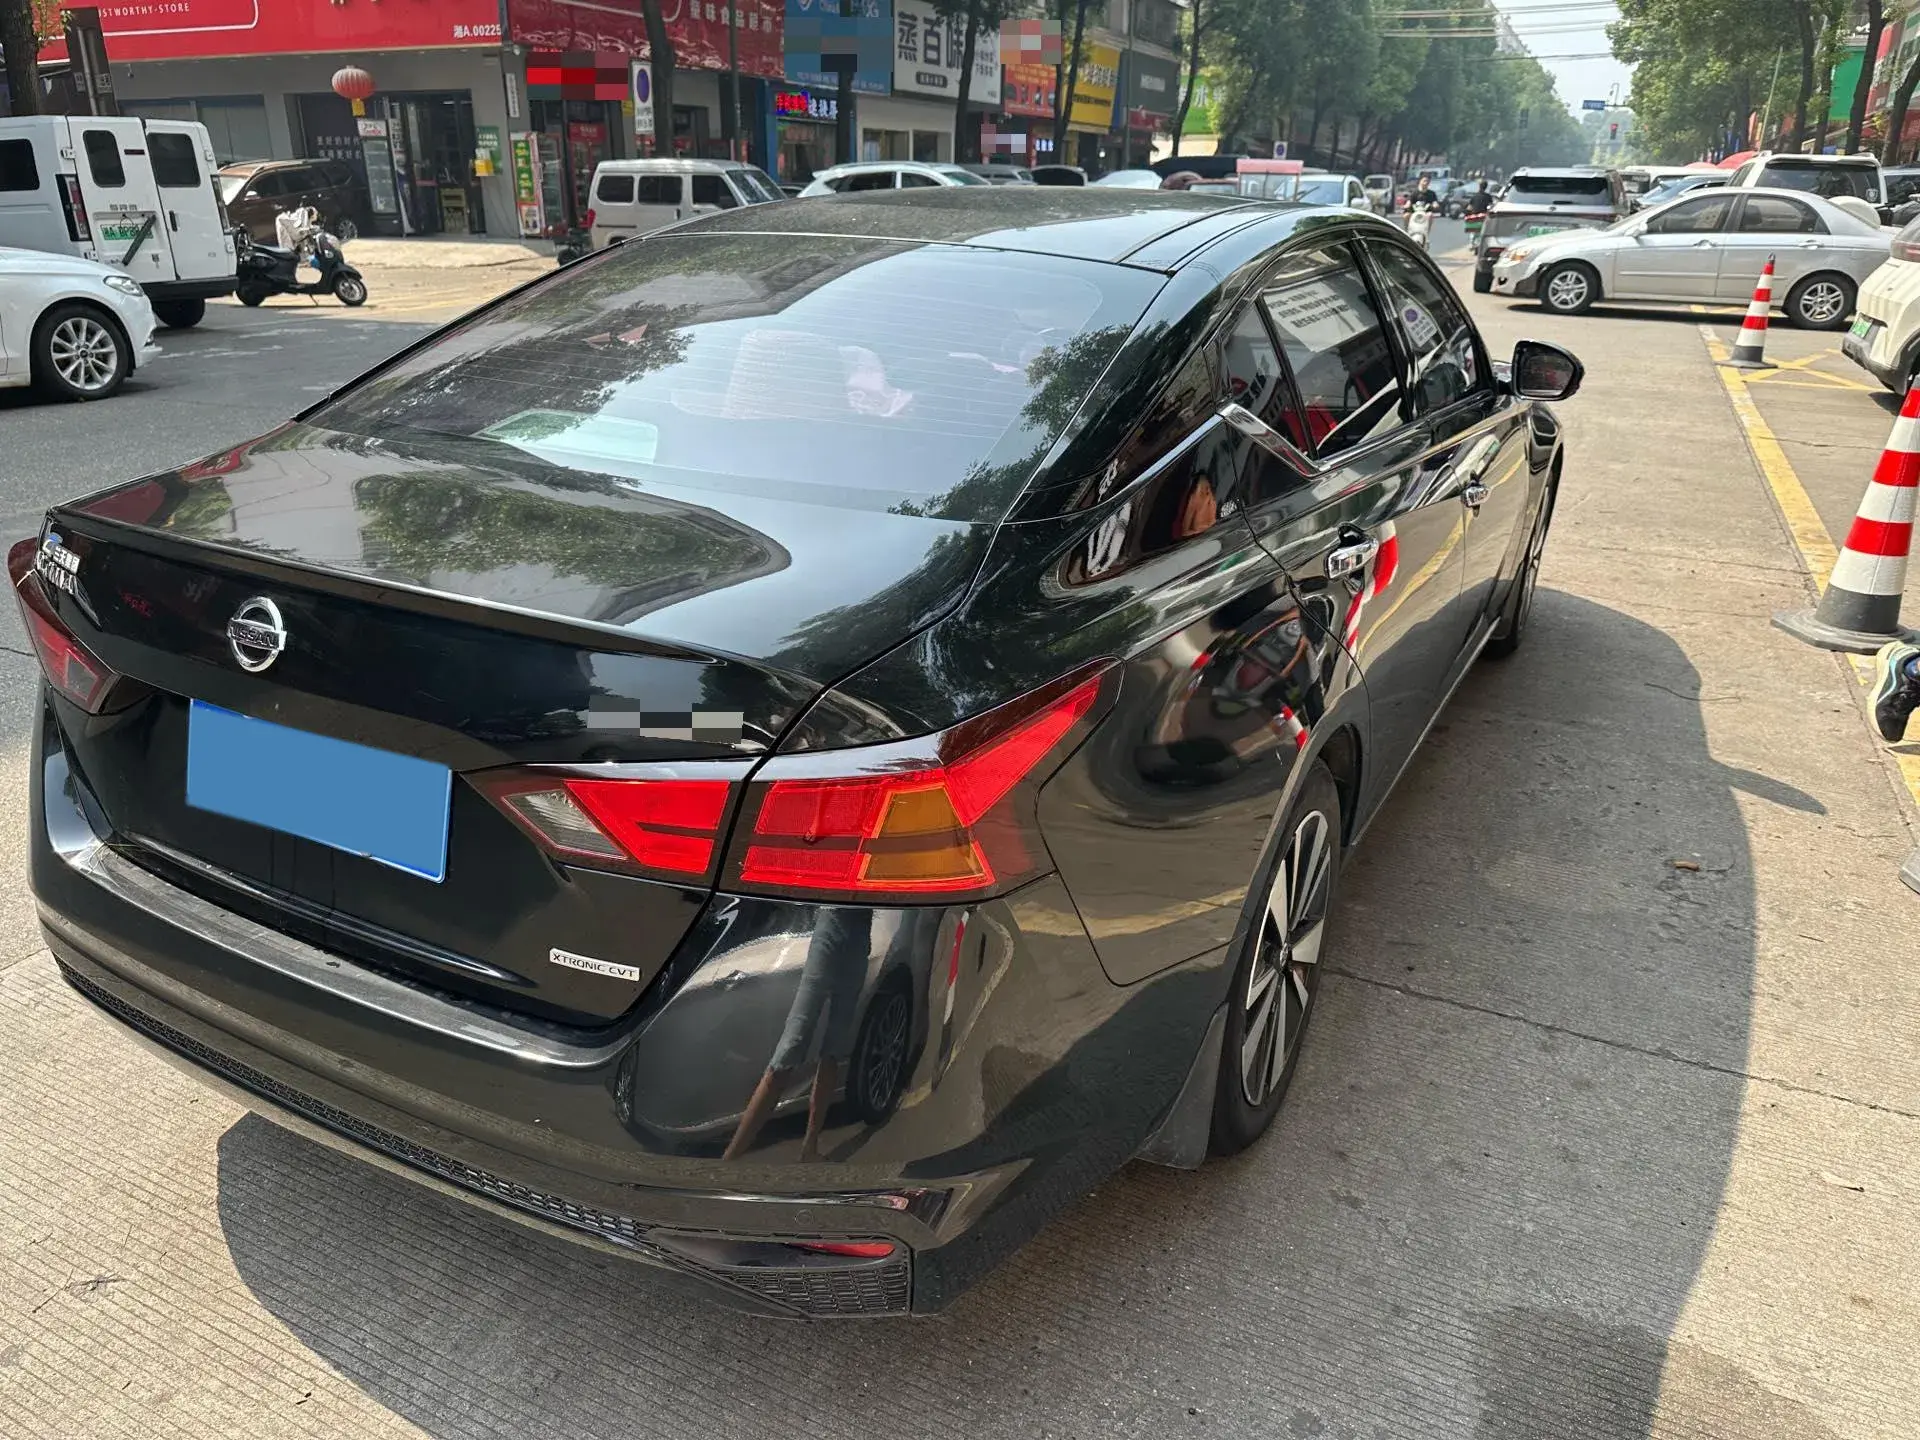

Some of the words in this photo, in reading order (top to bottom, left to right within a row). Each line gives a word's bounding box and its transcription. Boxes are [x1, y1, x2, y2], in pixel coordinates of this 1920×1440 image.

[898, 10, 966, 69] 蒸百味
[229, 624, 277, 648] NISSAN
[553, 953, 605, 971] XTRONIC
[609, 966, 635, 977] CVT
